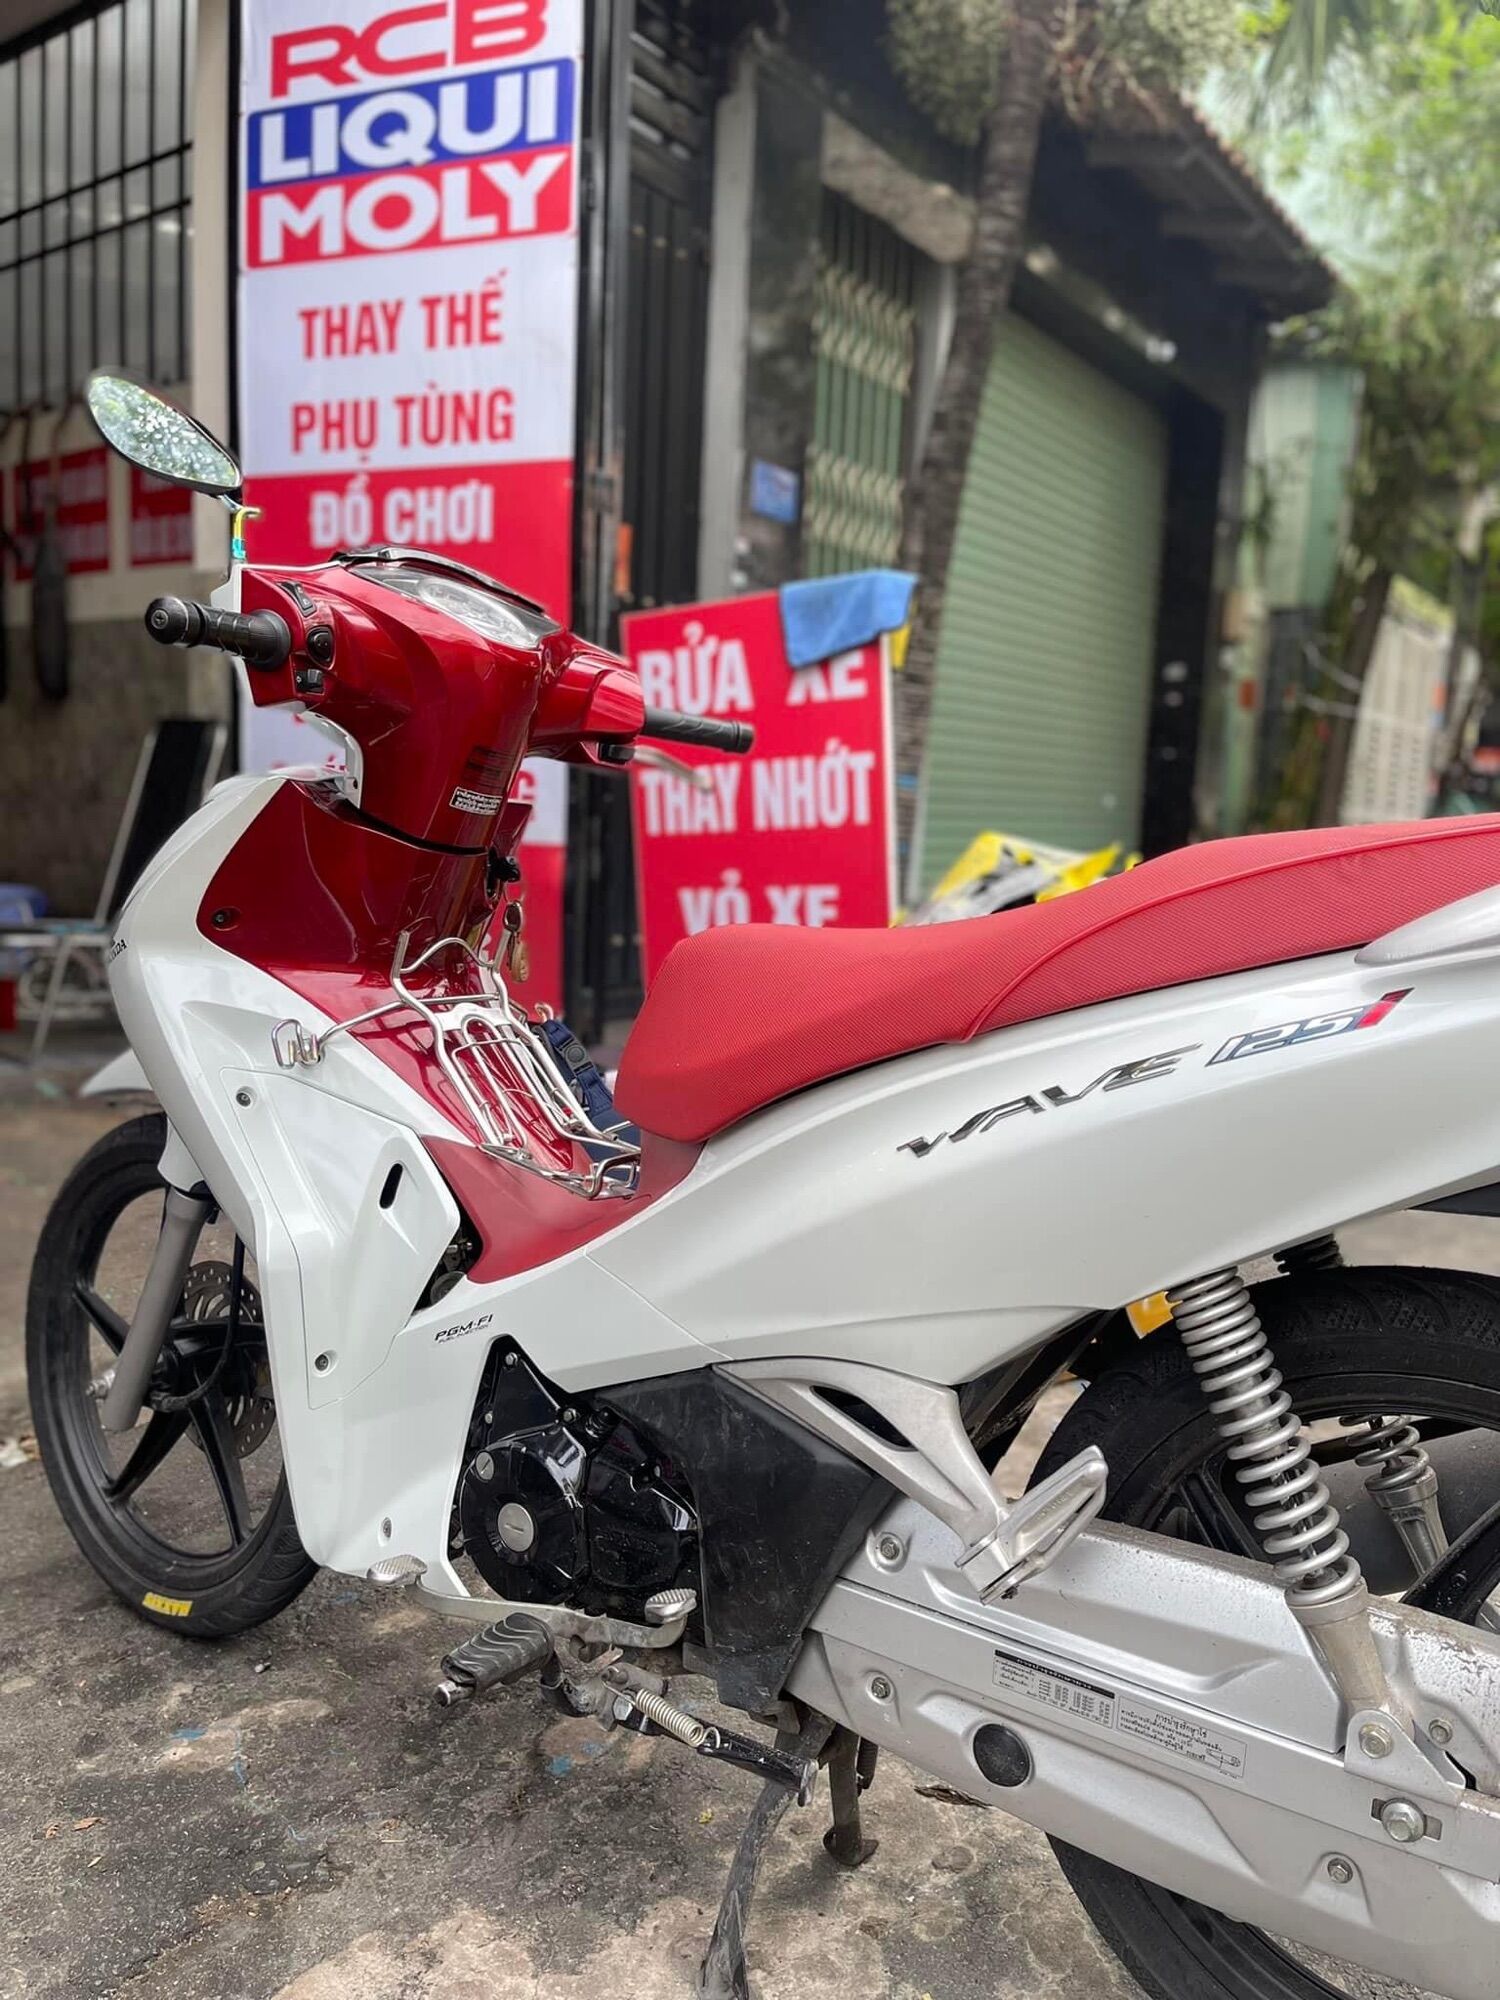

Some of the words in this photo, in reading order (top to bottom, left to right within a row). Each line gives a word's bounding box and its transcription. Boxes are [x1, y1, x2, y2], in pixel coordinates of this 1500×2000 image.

[271, 0, 549, 99] RCB
[260, 66, 558, 184] LIQUI
[258, 152, 568, 264] MOLY
[298, 299, 404, 361] THAY
[420, 269, 508, 350] THẾ
[291, 398, 378, 466] PHỤ
[394, 382, 515, 448] TÙNG
[384, 479, 495, 545] CHƠI
[637, 622, 754, 714] RỬA
[641, 761, 741, 837] THAY
[750, 738, 875, 832] NHỚT
[678, 869, 750, 936] VỎ
[1204, 986, 1415, 1068] 125i
